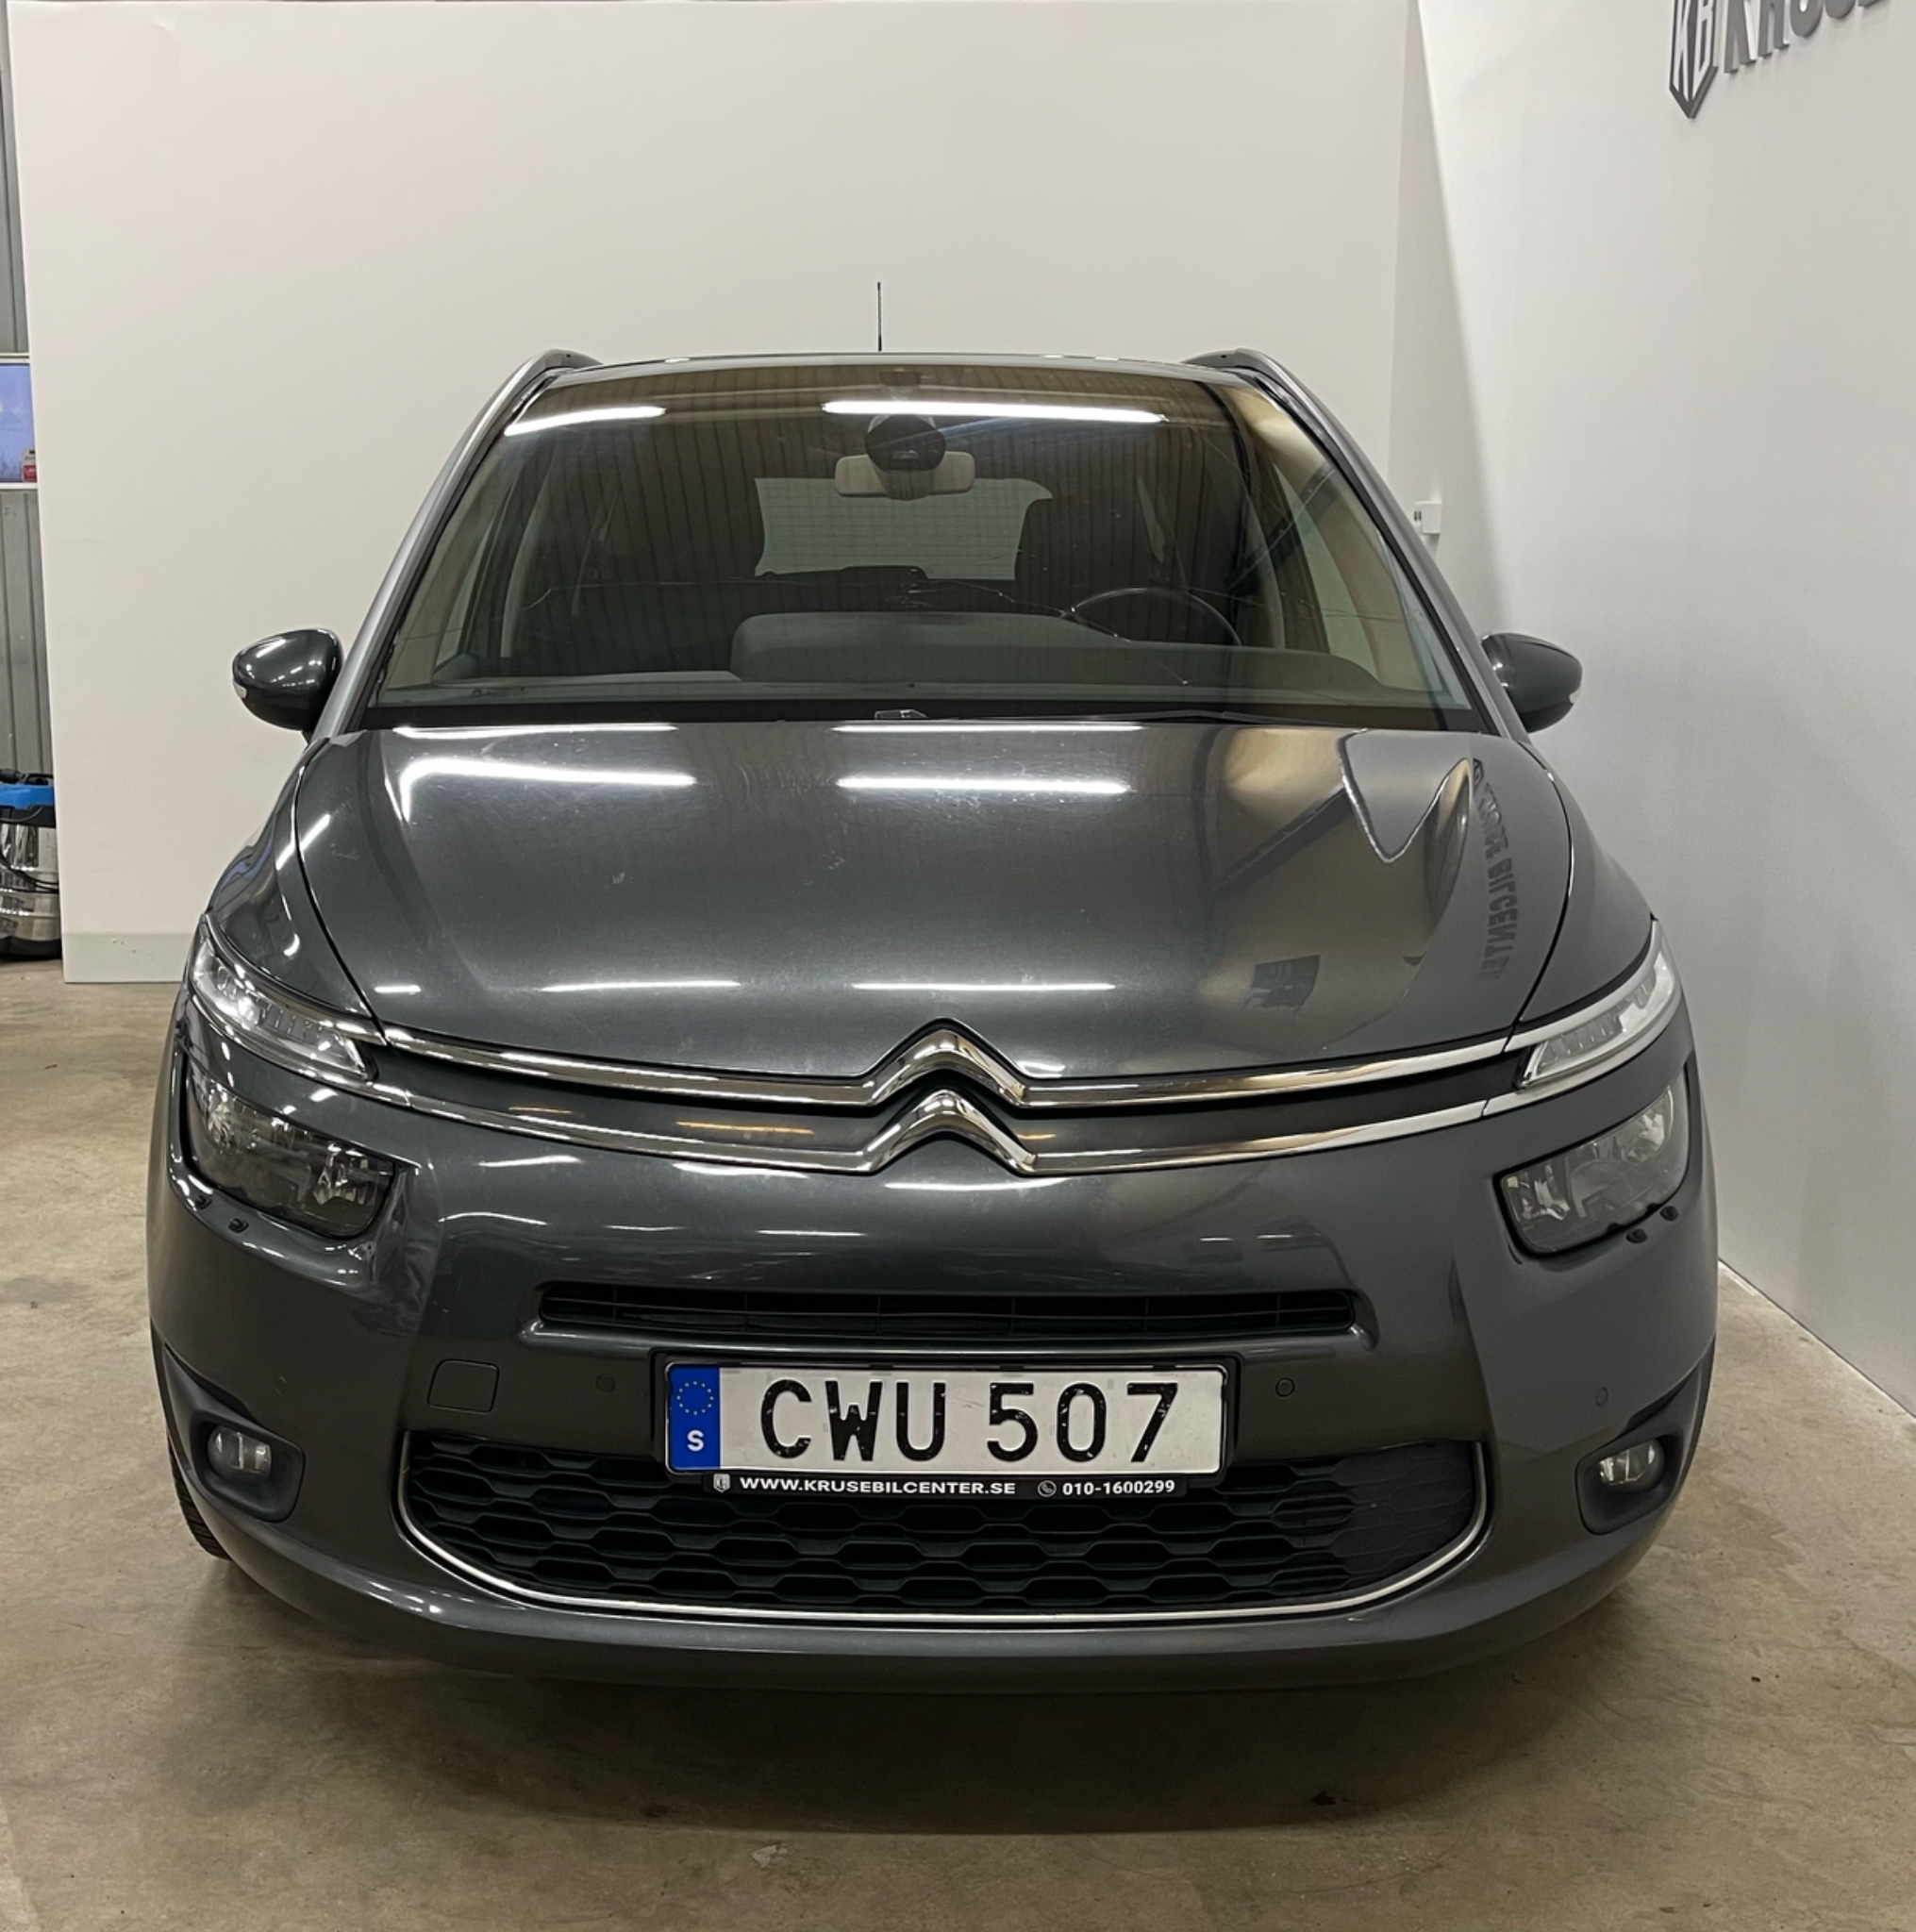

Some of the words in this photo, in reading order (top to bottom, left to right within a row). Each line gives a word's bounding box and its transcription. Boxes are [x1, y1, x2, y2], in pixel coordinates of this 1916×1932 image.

[760, 1379, 946, 1462] CWU
[987, 1382, 1178, 1462] 507
[687, 1430, 704, 1452] S
[740, 1476, 1016, 1494] WWW.KRUSEBILCENTER.SE
[1062, 1479, 1175, 1495] 010-1600299
